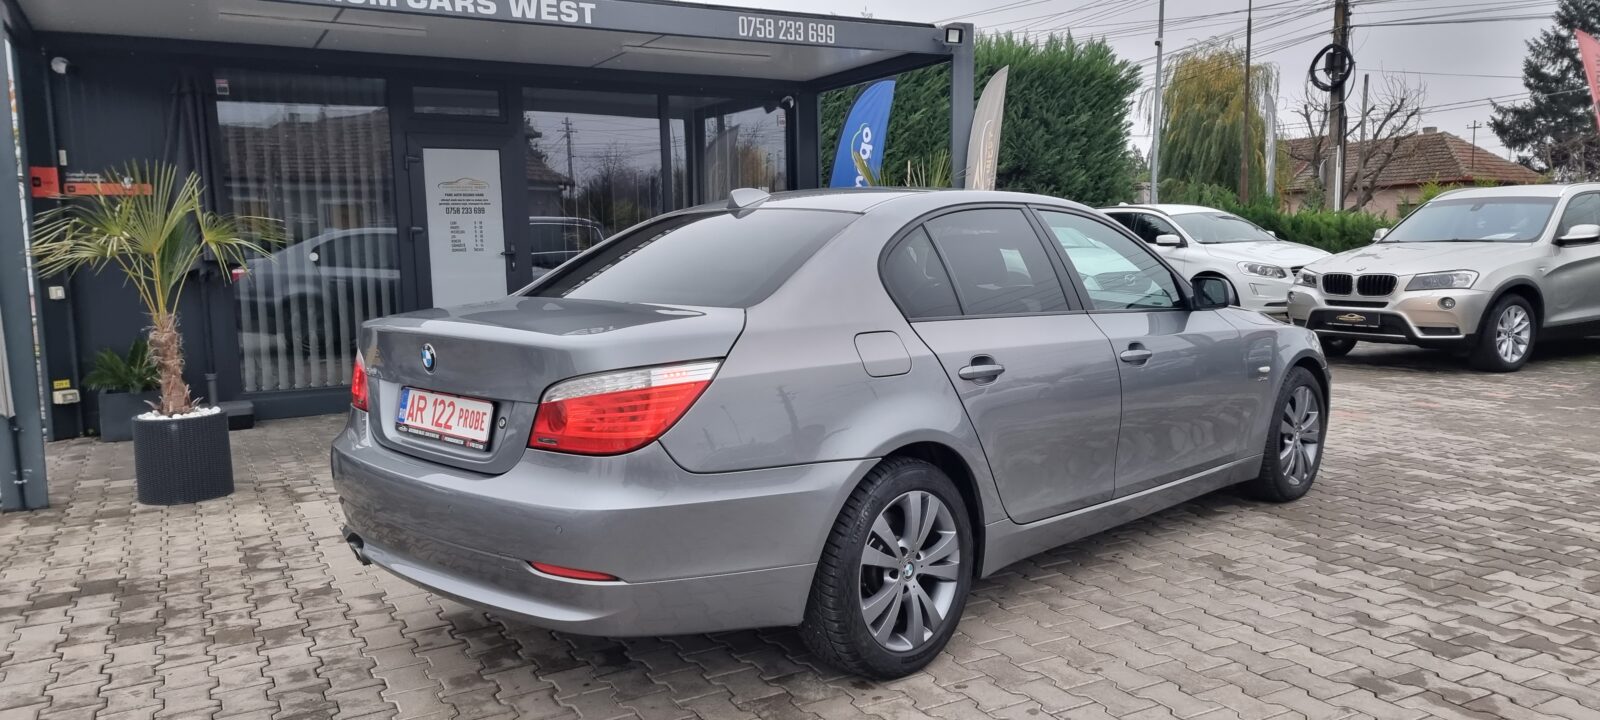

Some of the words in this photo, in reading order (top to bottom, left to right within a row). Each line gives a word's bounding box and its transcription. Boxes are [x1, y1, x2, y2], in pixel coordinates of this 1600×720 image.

[509, 0, 596, 24] WEST
[738, 16, 775, 39] 0758
[778, 20, 804, 41] 233
[808, 23, 835, 44] 699
[445, 207, 461, 215] 0758
[461, 207, 473, 215] 233
[407, 394, 428, 424] AR
[431, 398, 456, 431] 122
[457, 407, 487, 432] PROBE
